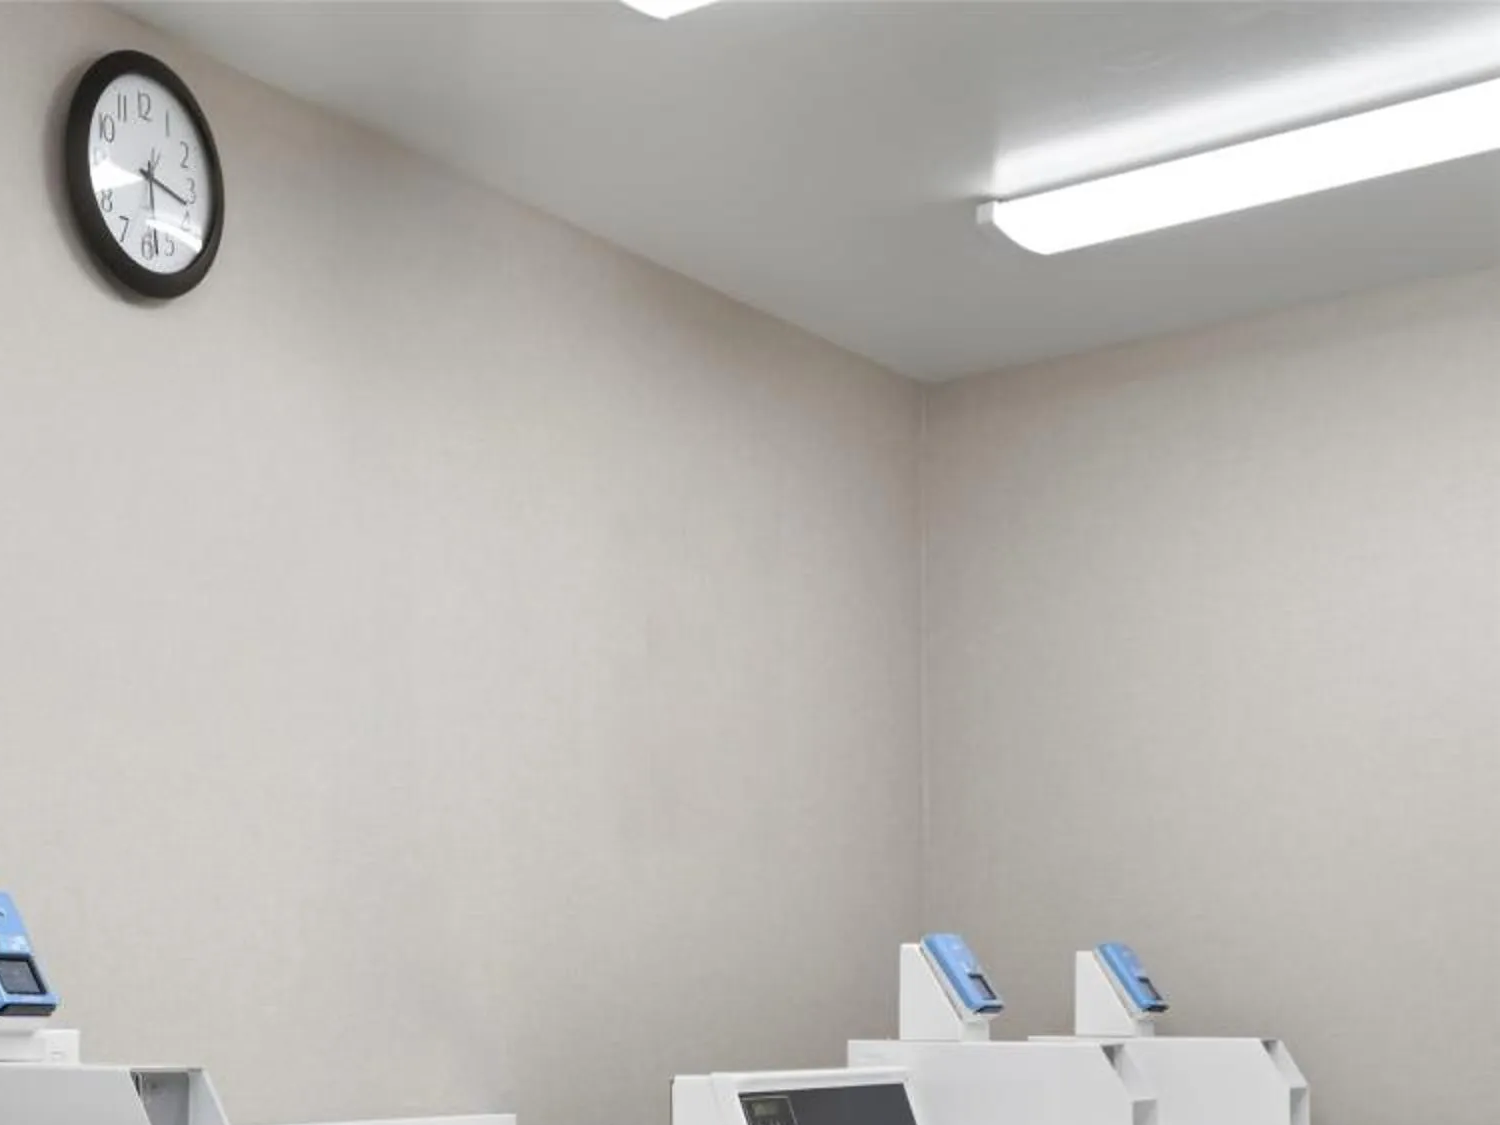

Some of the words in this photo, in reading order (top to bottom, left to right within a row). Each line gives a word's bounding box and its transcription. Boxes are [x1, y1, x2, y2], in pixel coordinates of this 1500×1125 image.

[117, 92, 127, 122] 11
[137, 90, 152, 121] 12
[99, 113, 115, 143] 10
[180, 141, 189, 168] 2
[119, 215, 129, 243] 7
